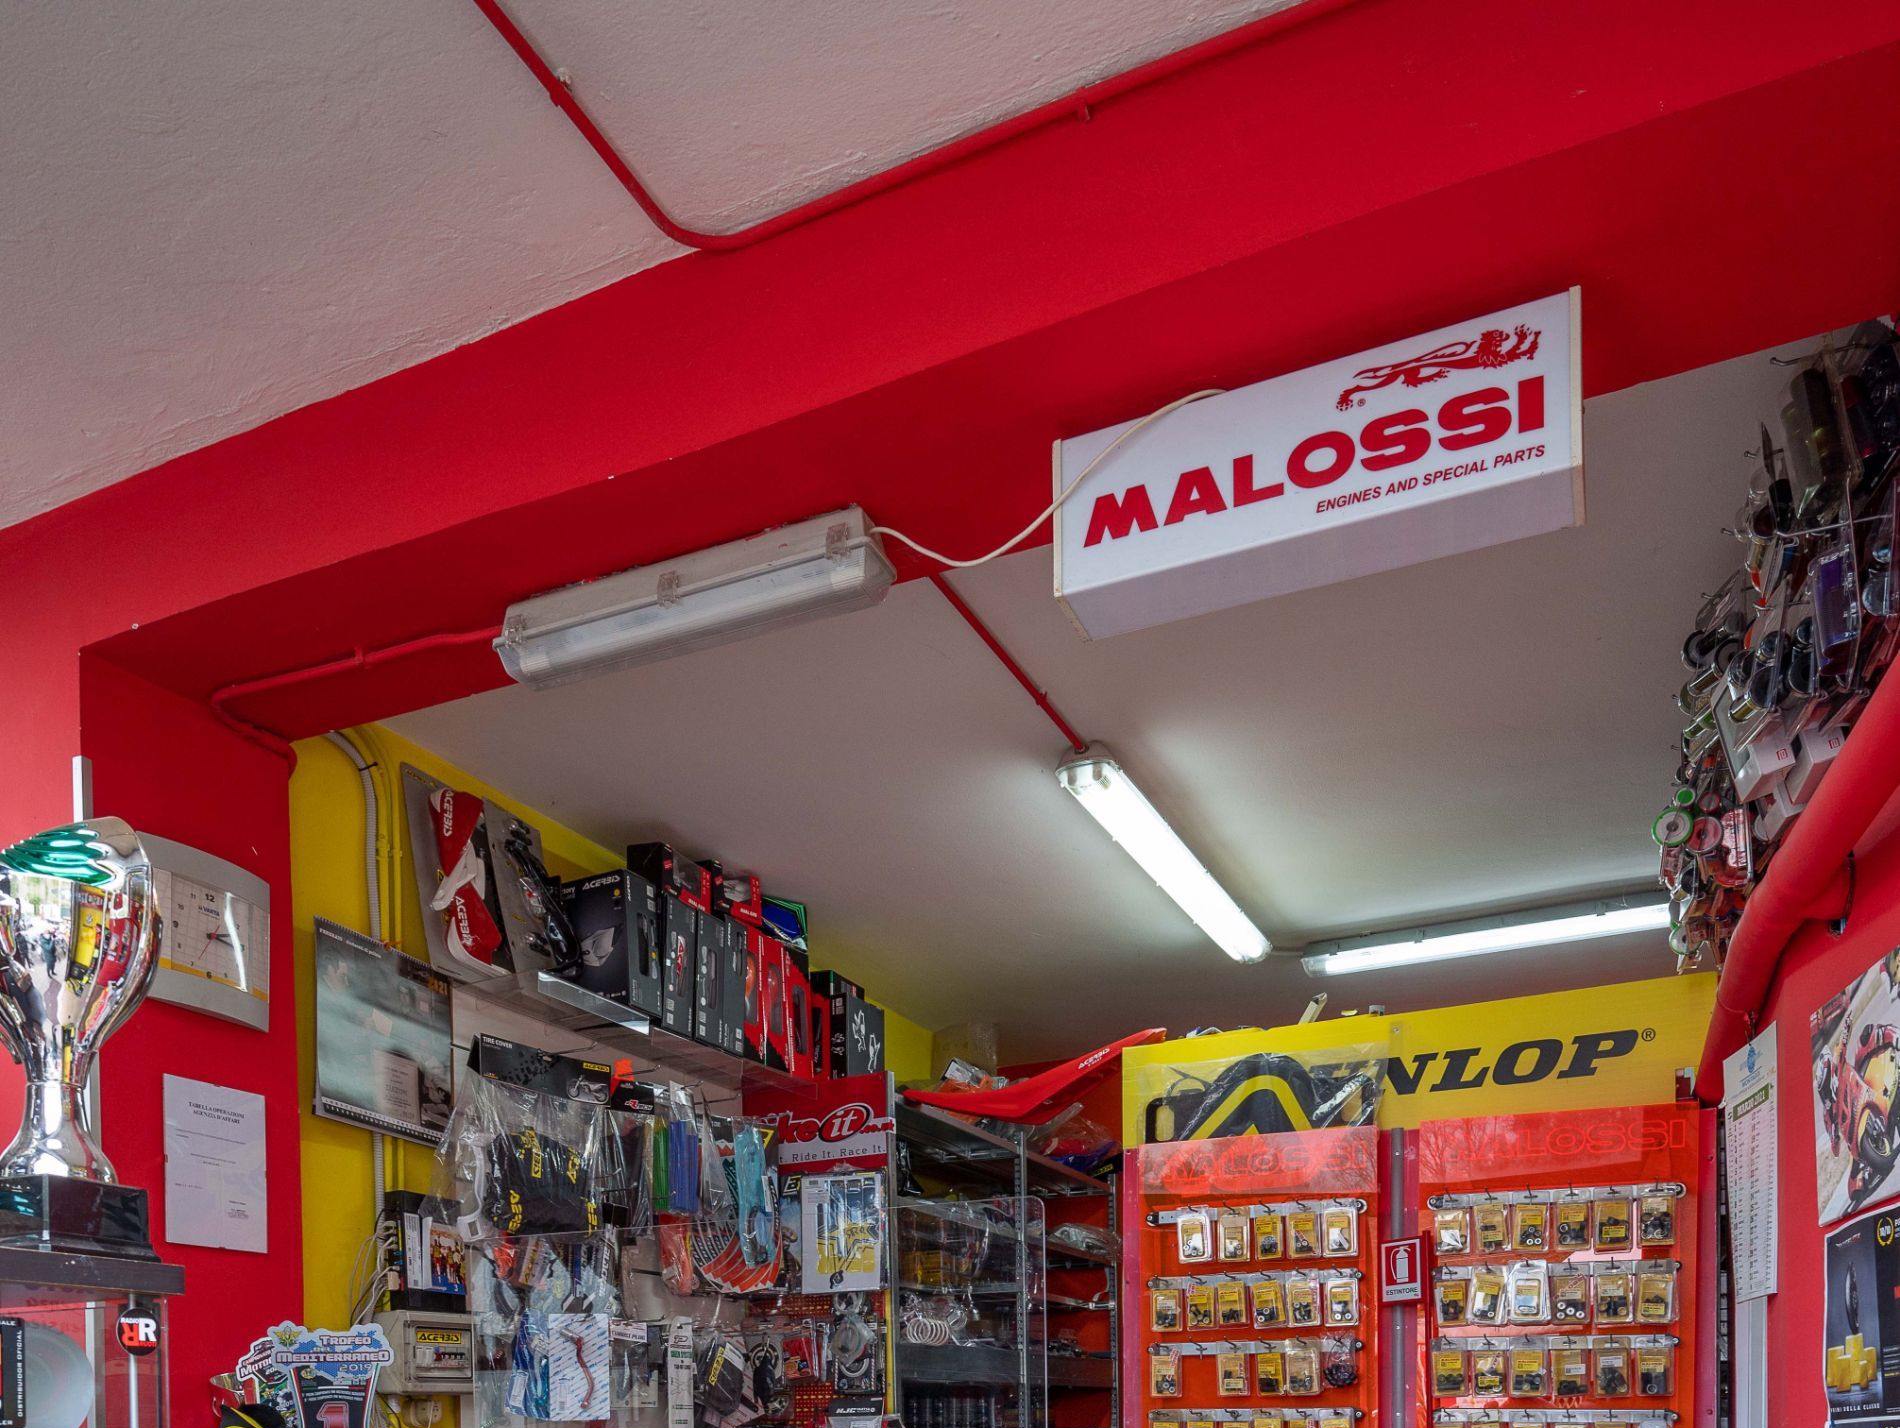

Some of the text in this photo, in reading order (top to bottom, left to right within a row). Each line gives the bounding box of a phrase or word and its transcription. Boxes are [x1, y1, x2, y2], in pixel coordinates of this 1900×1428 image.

[1083, 375, 1545, 548] MALOSSI
[1315, 444, 1545, 513] ENGINES AND SPECIAL PARTS
[205, 893, 215, 902] 12
[483, 1036, 513, 1049] TIRE COVER
[1310, 1028, 1639, 1097] NLOP
[188, 1101, 212, 1111] TABELLA
[792, 1151, 817, 1163] Ride
[822, 1150, 835, 1160] It.
[839, 1146, 868, 1157] Race
[872, 1144, 886, 1154] It.
[1385, 1287, 1418, 1296] ESTINTORE
[319, 1335, 372, 1345] TROFEO
[276, 1349, 390, 1363] MEDITERRANEO
[339, 1363, 373, 1372] 2019
